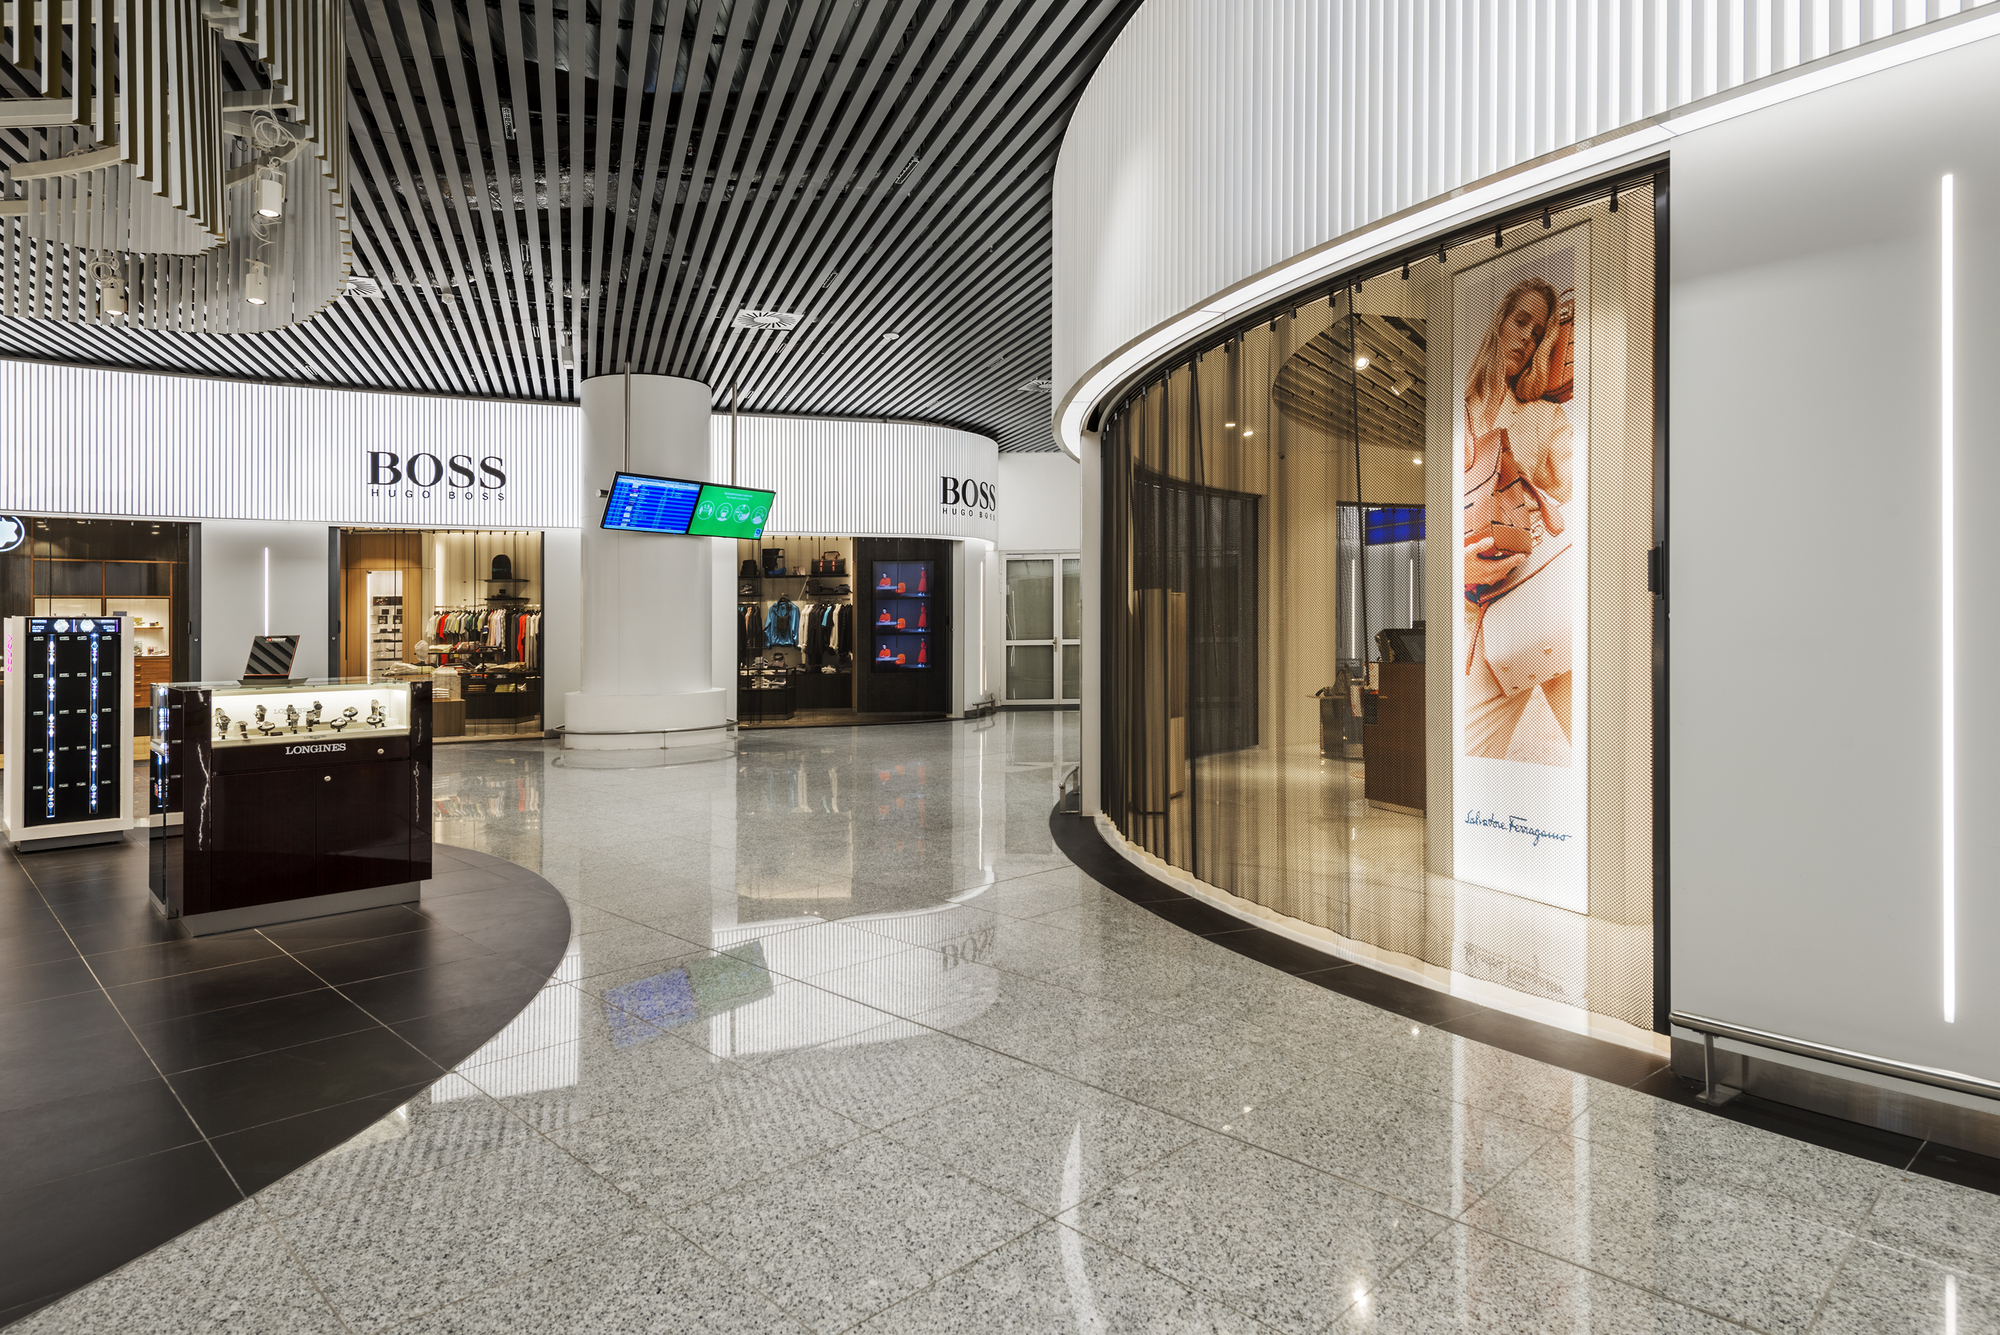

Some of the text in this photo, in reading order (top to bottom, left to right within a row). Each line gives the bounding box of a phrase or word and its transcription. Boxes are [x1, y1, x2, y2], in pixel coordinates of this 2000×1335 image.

[367, 450, 507, 489] BOSS
[371, 488, 505, 501] HUGO BOSS
[940, 476, 996, 511] BOSS
[942, 508, 996, 521] HUGO BOSS
[285, 743, 347, 755] LONGINES
[1464, 809, 1573, 847] Salvatore Ferragamo
